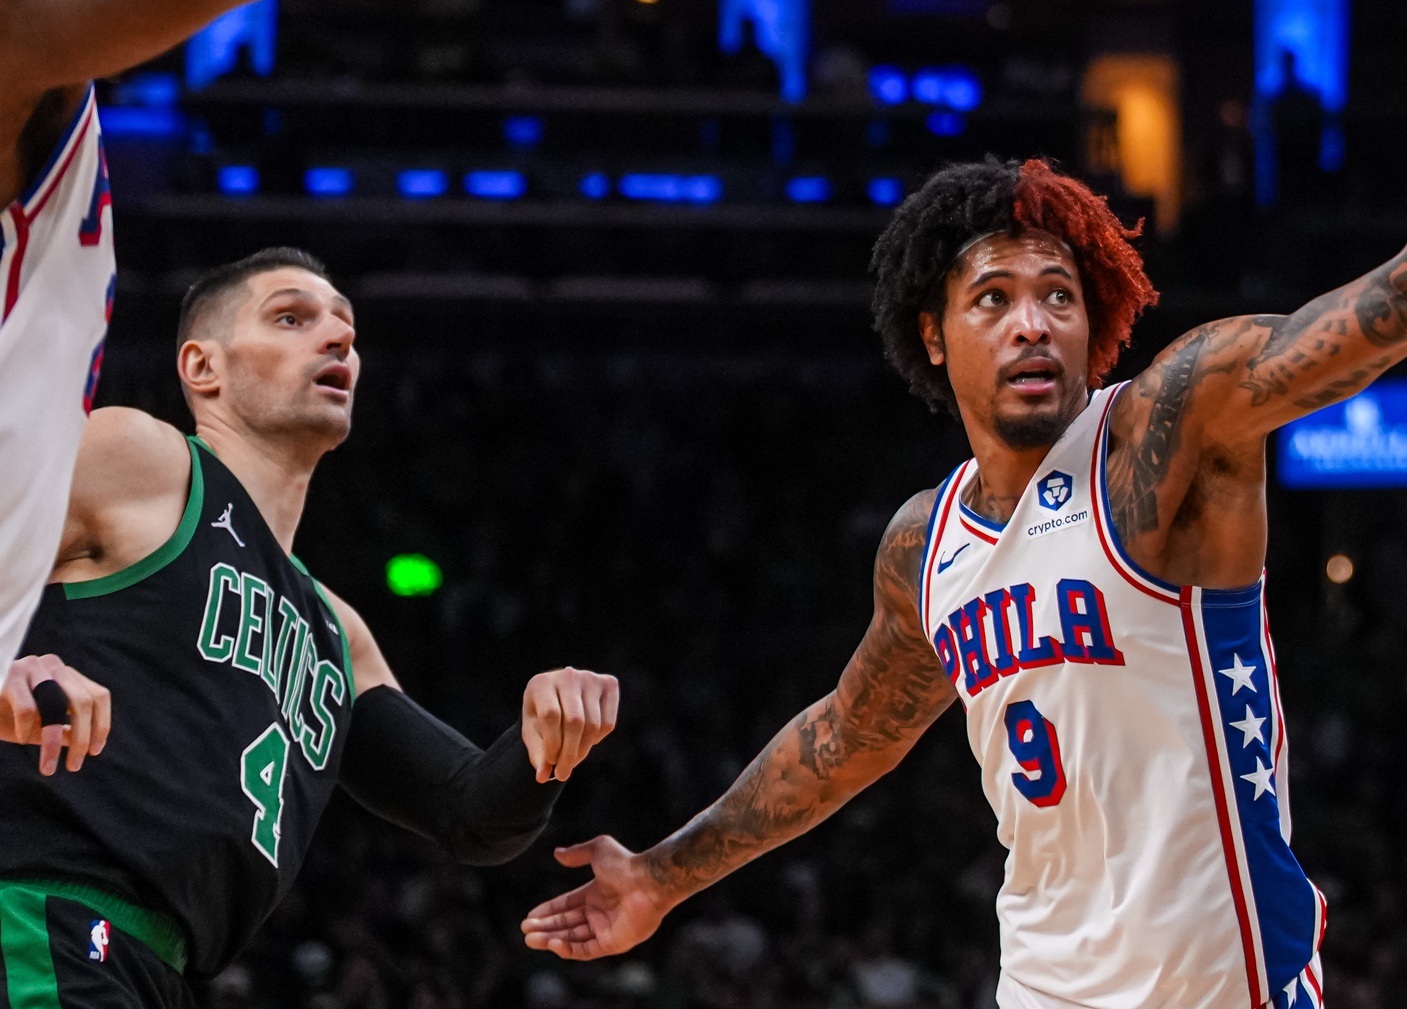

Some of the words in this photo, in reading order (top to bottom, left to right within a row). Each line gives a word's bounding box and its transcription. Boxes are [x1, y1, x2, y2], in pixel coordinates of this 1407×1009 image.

[1027, 510, 1088, 536] crypto.com
[197, 562, 345, 770] CELTICS
[933, 578, 1125, 697] PHILA
[241, 722, 290, 868] 4
[1004, 700, 1066, 808] 9
